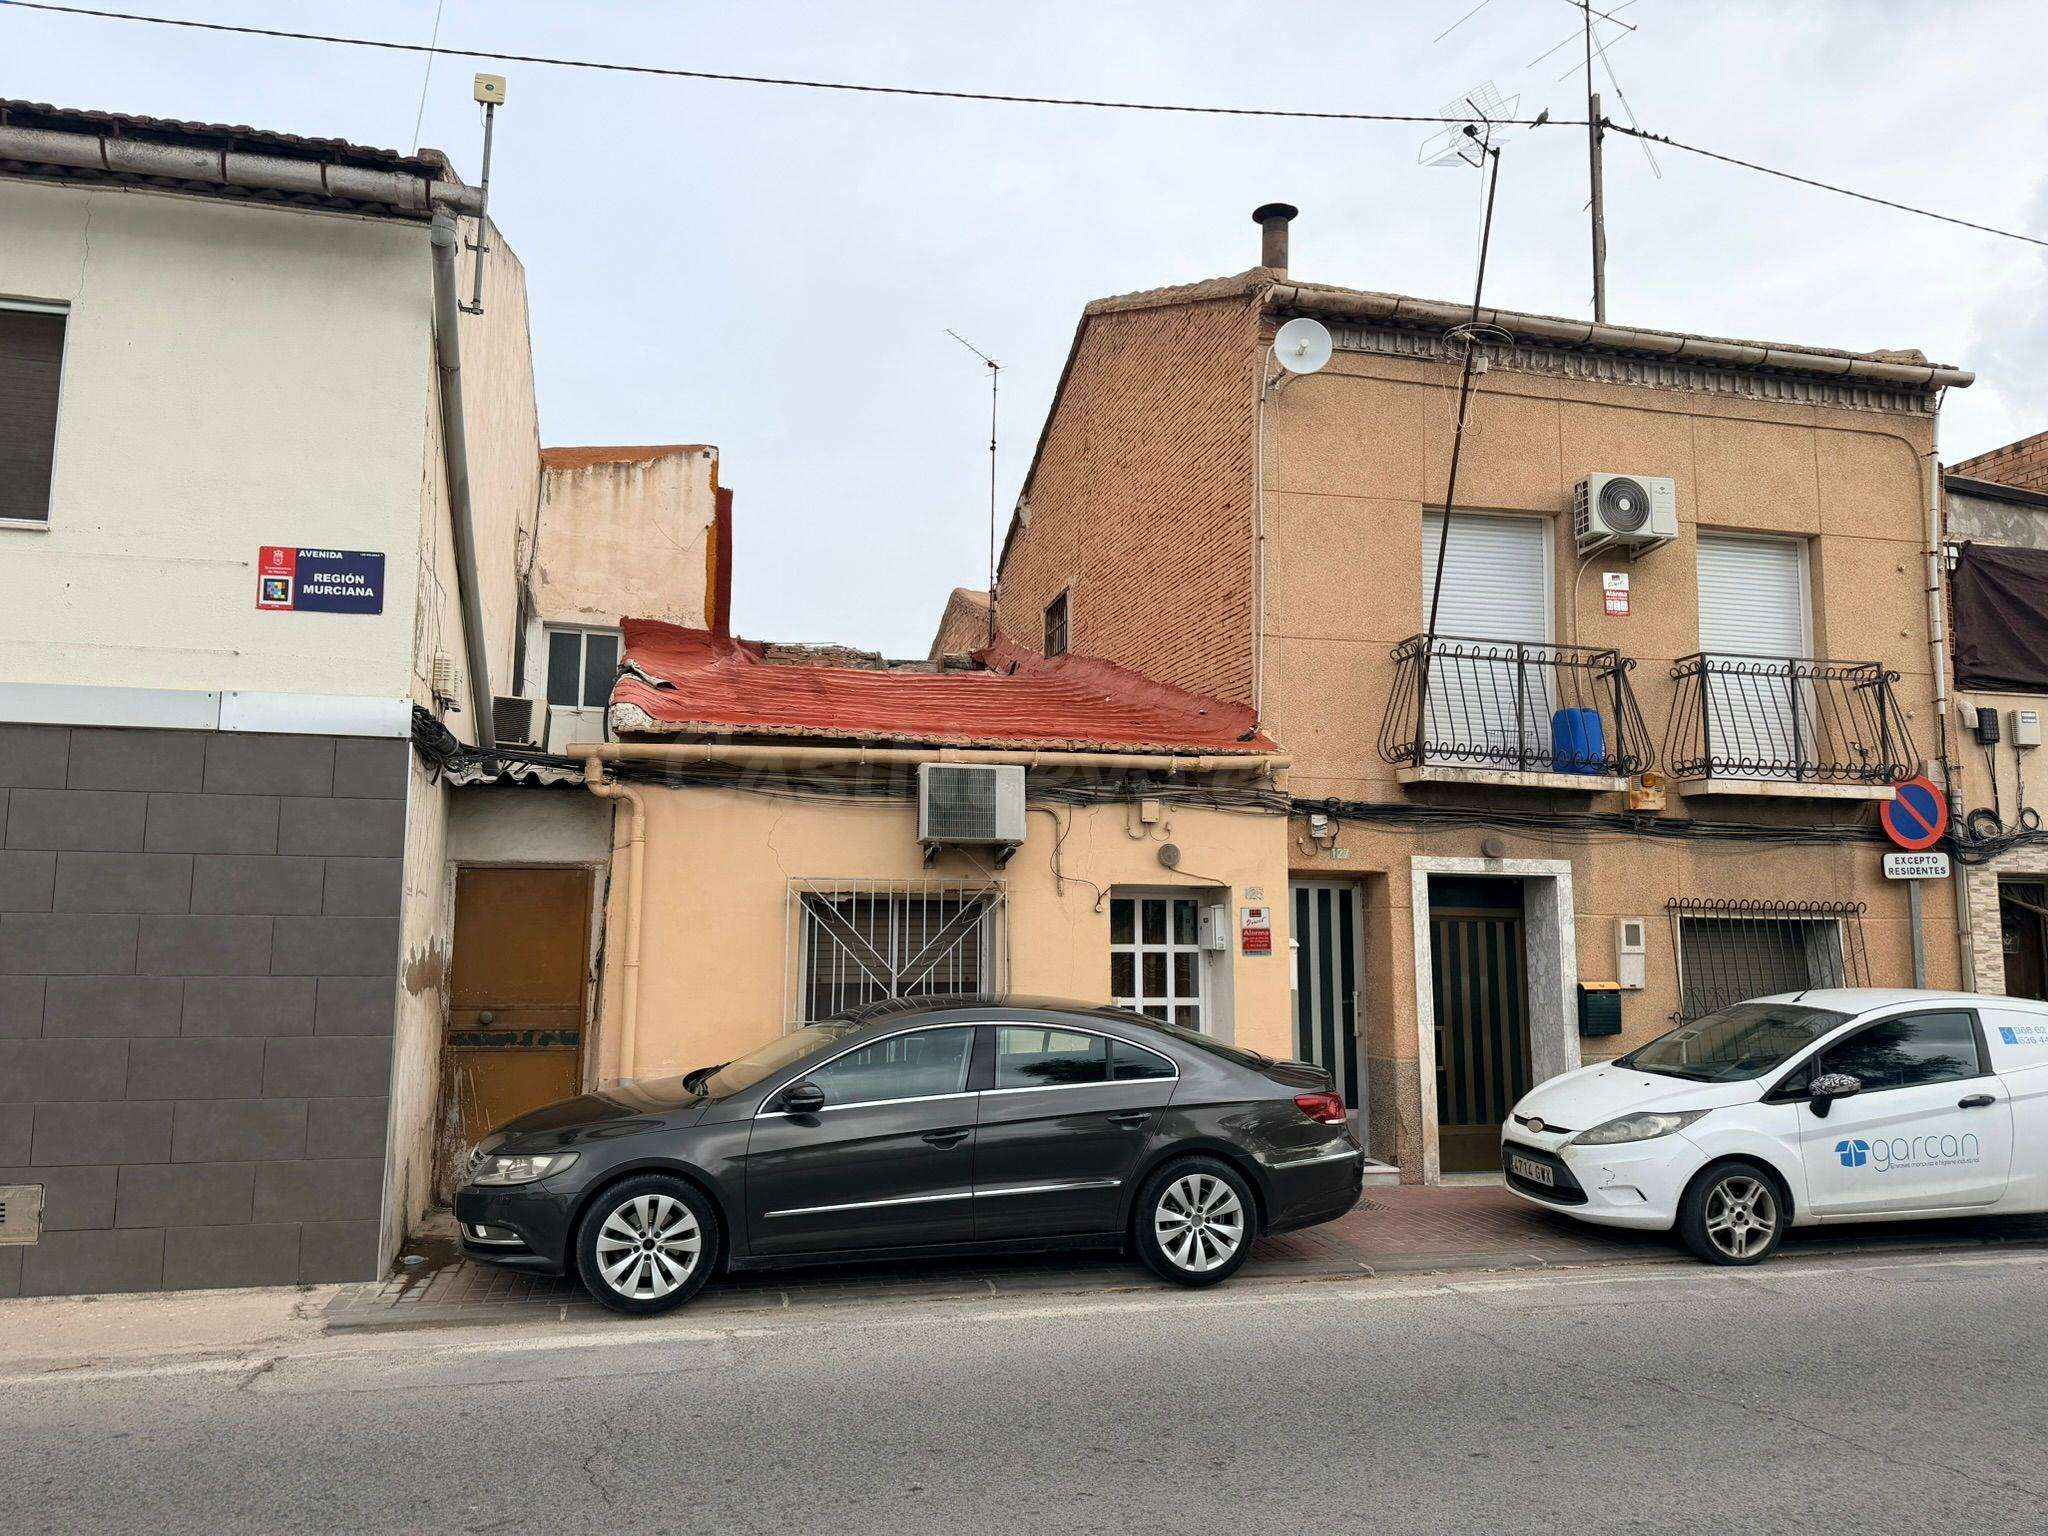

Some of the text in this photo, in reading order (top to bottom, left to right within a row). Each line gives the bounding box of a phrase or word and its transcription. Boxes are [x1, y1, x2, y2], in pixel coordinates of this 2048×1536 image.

[298, 550, 343, 559] AVENIDA
[313, 573, 365, 584] REGIÓN
[303, 585, 374, 597] MURCIANA
[1894, 856, 1938, 865] EXCEPTO
[1888, 867, 1946, 876] RESIDENTES
[1872, 1133, 1979, 1173] garcan
